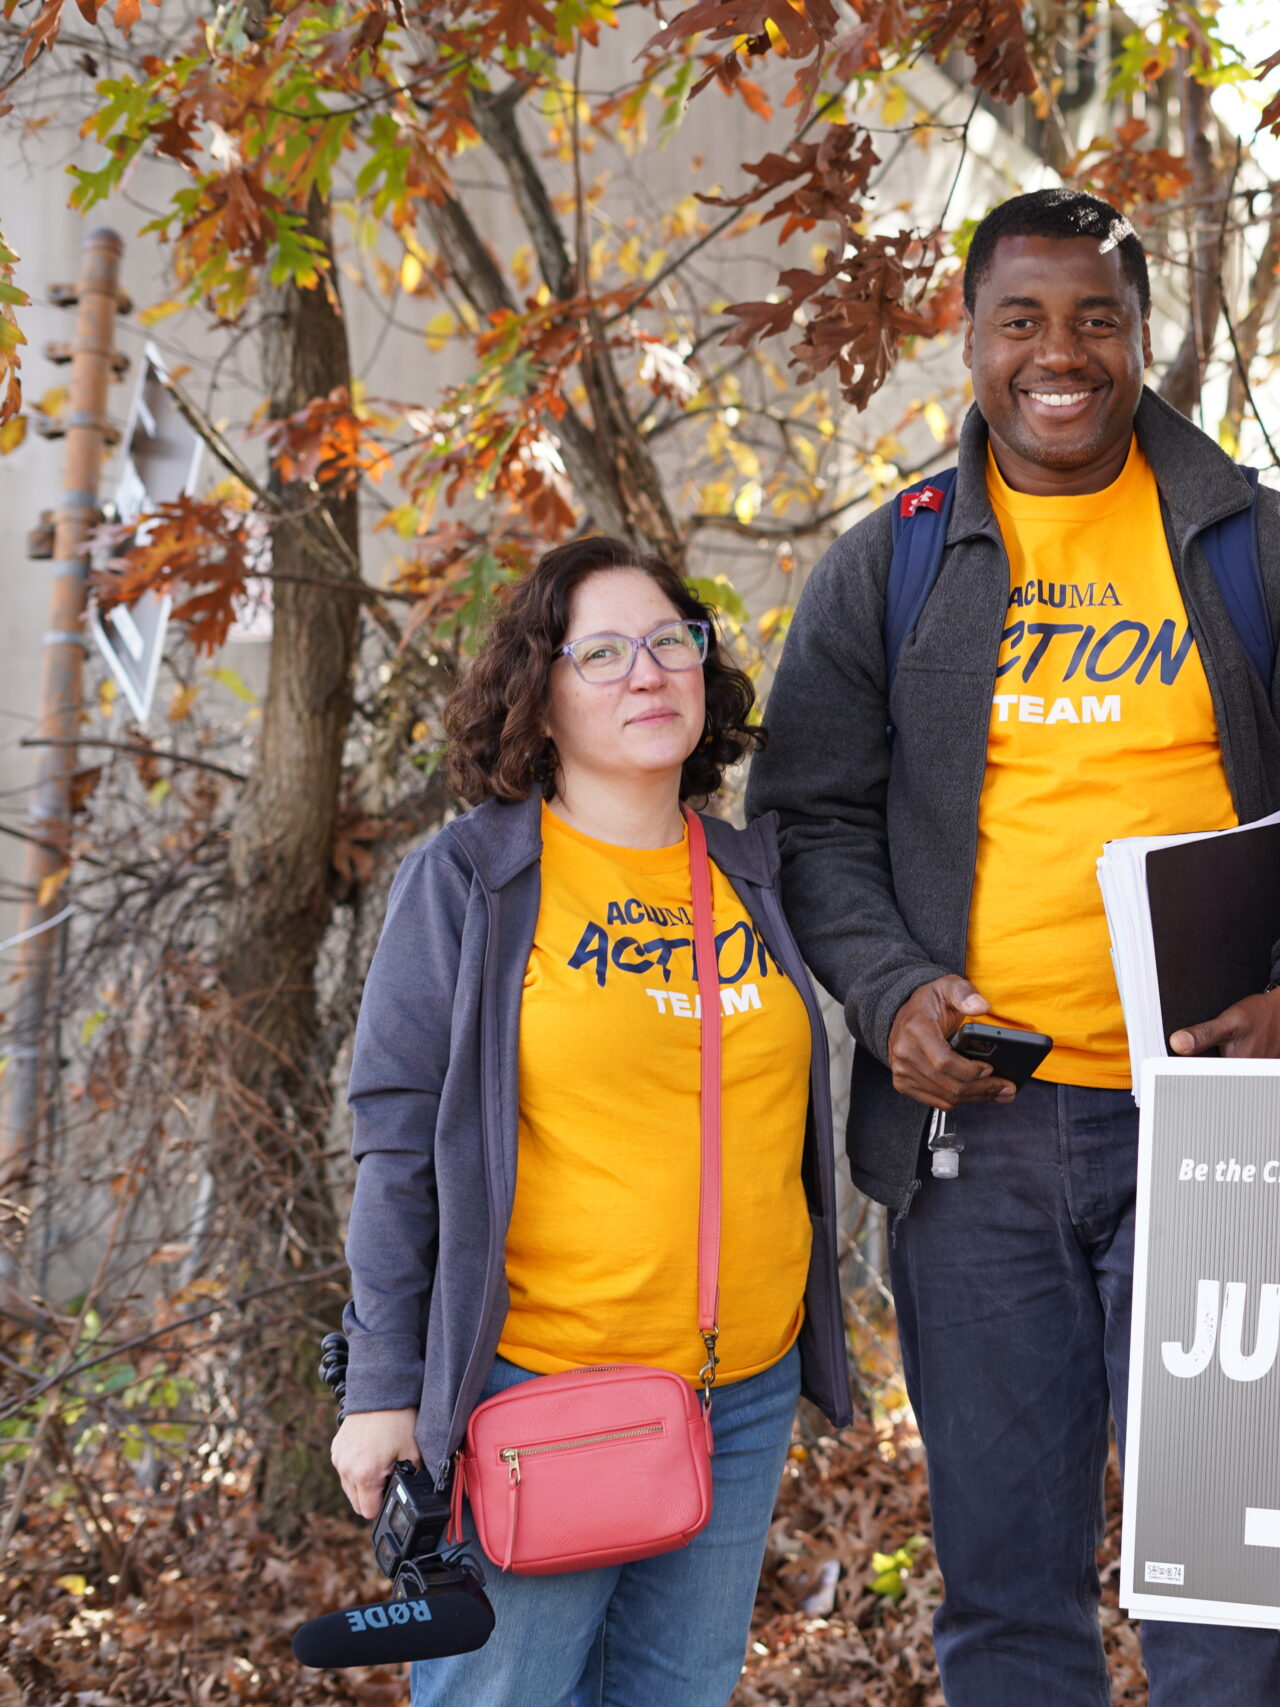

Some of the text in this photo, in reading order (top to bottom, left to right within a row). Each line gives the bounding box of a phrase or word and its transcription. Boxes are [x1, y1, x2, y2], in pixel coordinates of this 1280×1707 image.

[996, 618, 1195, 686] CTION
[992, 694, 1121, 724] TEAM
[607, 898, 715, 927] ACLUM
[1178, 1158, 1208, 1182] Be
[1215, 1158, 1256, 1183] the
[345, 1600, 432, 1632] RØDE
